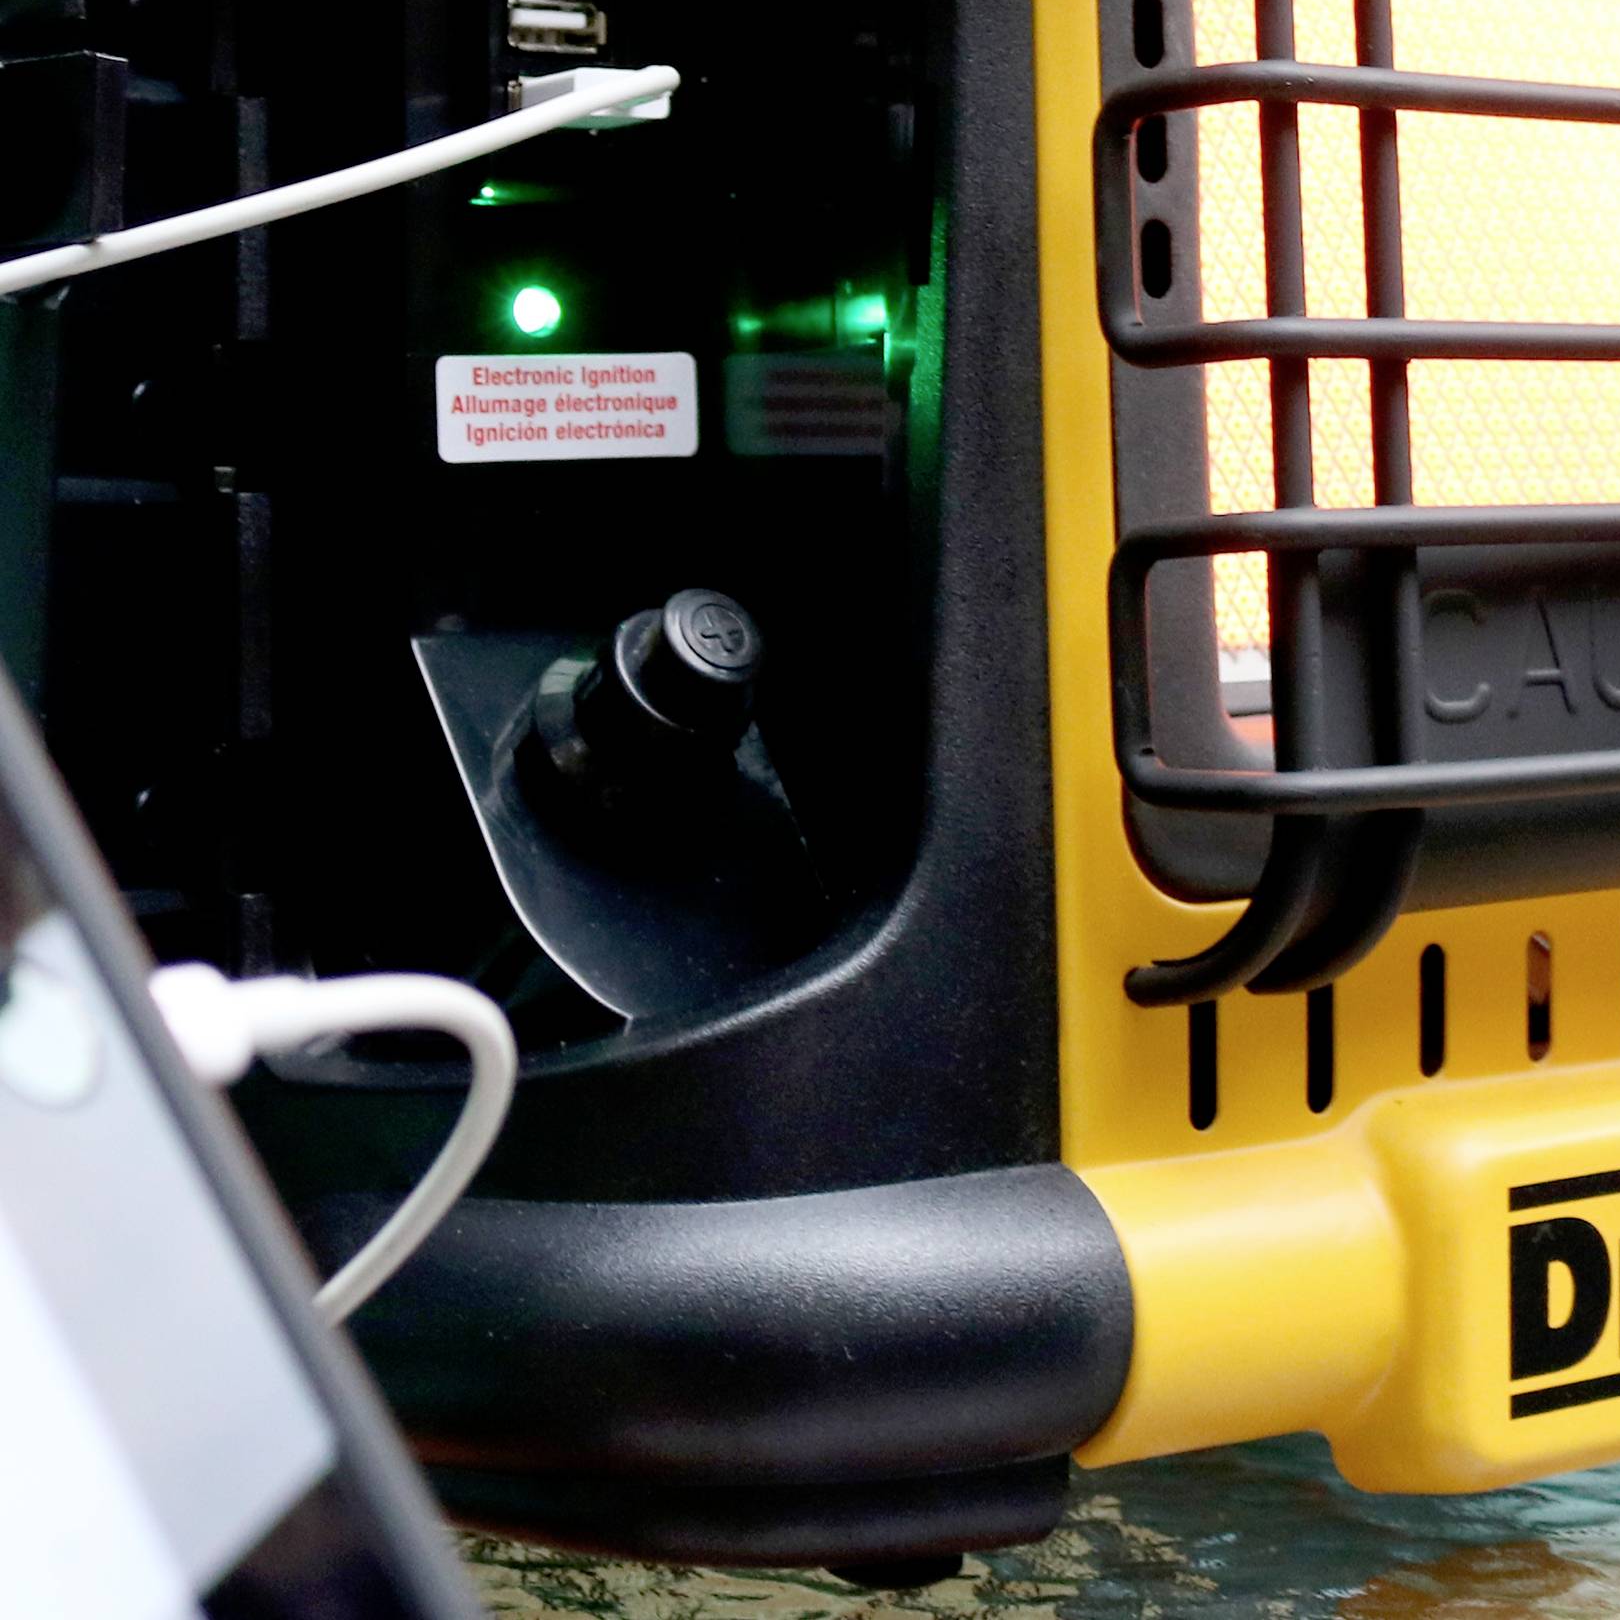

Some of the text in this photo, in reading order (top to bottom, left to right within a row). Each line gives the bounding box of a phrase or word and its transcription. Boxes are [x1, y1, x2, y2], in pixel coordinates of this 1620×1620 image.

[471, 366, 657, 388] Electronic Ignition
[451, 393, 679, 418] Allumage électronique
[465, 421, 667, 446] Ignición electrónica
